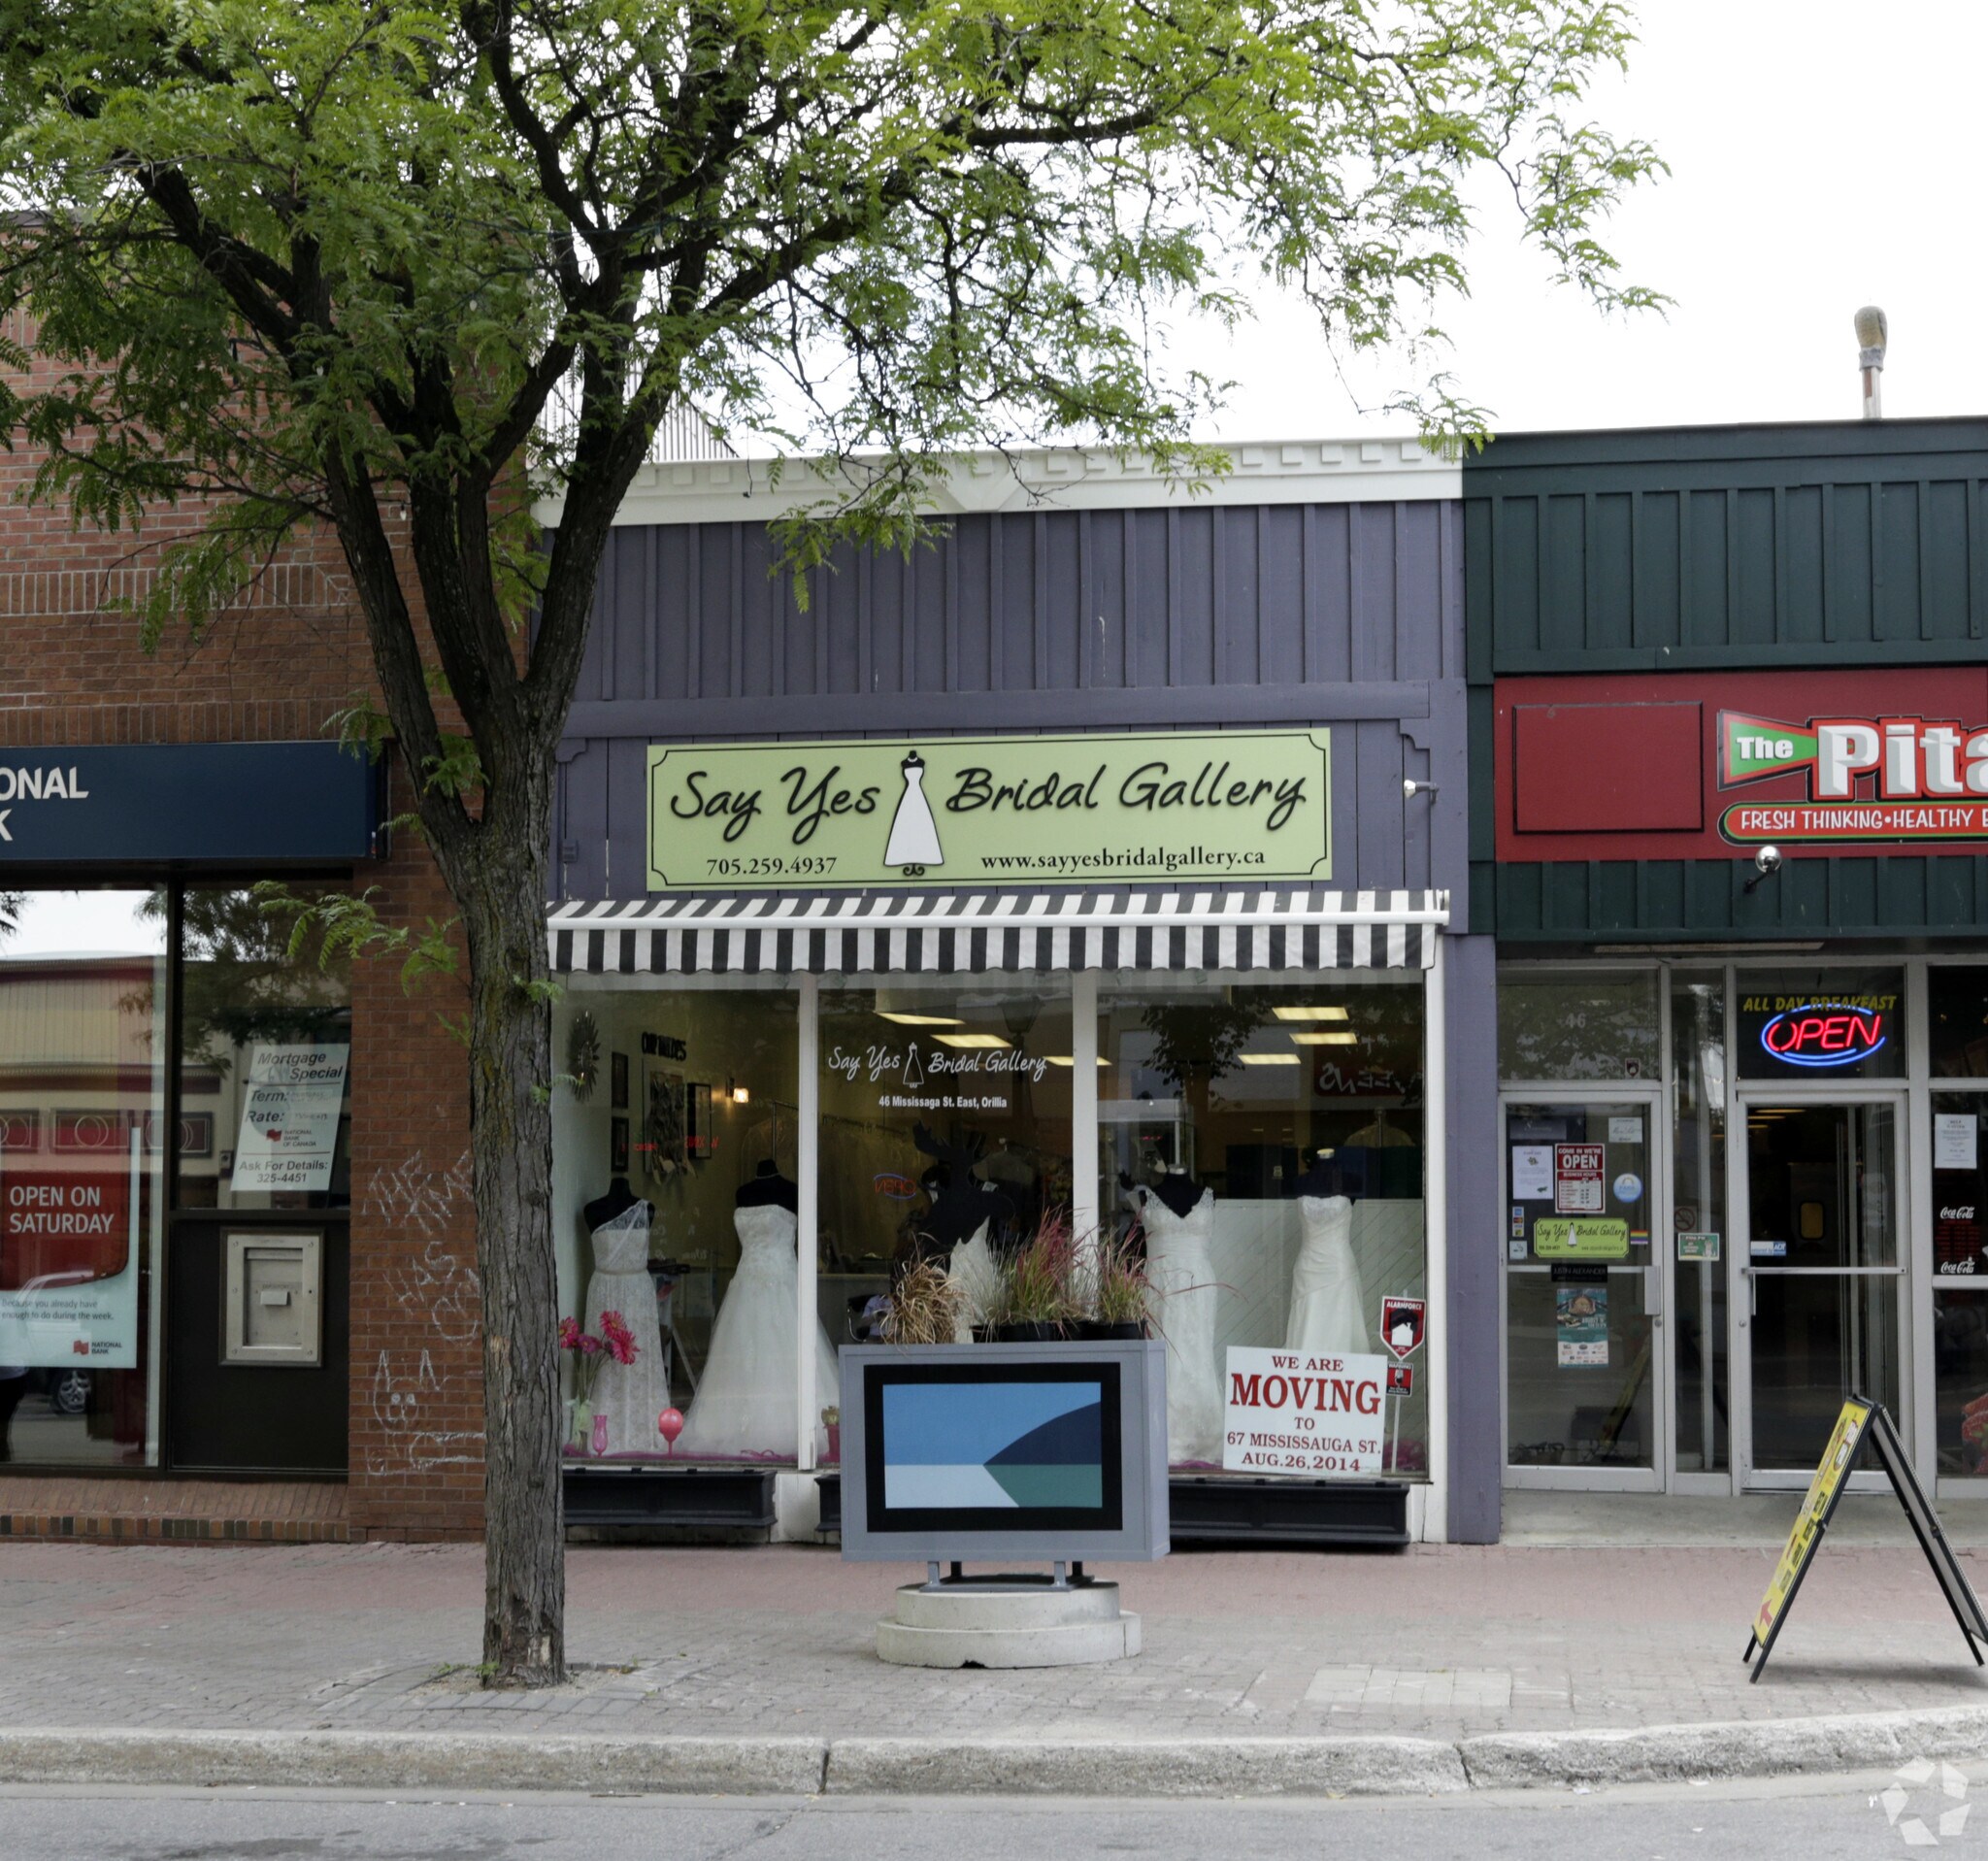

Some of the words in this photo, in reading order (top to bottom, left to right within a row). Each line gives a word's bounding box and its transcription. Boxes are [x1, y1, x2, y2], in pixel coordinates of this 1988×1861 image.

[1736, 736, 1794, 760] The
[0, 765, 89, 801] ONAL
[670, 770, 762, 843] Say
[779, 765, 880, 846] Yes
[945, 764, 1108, 813] Bridal
[1118, 761, 1307, 832] Gallery
[1740, 810, 1796, 830] FRESH
[706, 856, 838, 876] 705.259.4937
[980, 846, 1266, 874] www.sayyesbridalgallery.ca
[1743, 996, 1770, 1012] ALL
[1774, 996, 1806, 1012] DAY
[1809, 995, 1897, 1012] BREAKFAST
[1767, 1015, 1881, 1052] OPEN
[257, 1052, 327, 1067] Mortgage
[828, 1046, 861, 1080] Say
[866, 1045, 901, 1081] Yes
[927, 1050, 982, 1074] Bridal
[985, 1049, 1047, 1082] Gallery
[290, 1066, 344, 1082] Special
[251, 1089, 290, 1103] Term:
[878, 1096, 890, 1108] 46
[892, 1095, 941, 1110] Mississaga
[943, 1096, 955, 1108] St.
[957, 1096, 979, 1110] East,
[981, 1095, 1008, 1109] Orillia
[245, 1111, 285, 1123] Rate:
[239, 1160, 261, 1171] Ask
[265, 1160, 282, 1171] For
[286, 1160, 329, 1171] Details:
[1563, 1154, 1599, 1169] OPEN
[256, 1173, 307, 1183] 325-4451
[10, 1185, 64, 1207] OPEN
[70, 1185, 101, 1207] ON
[9, 1213, 115, 1234] SATURDAY
[1538, 1223, 1551, 1242] Say
[1553, 1223, 1568, 1243] Yes
[1575, 1224, 1598, 1237] Bridal
[1600, 1224, 1626, 1243] Gallery
[35, 1301, 49, 1310] you
[50, 1299, 78, 1310] already
[80, 1299, 98, 1308] have
[1386, 1301, 1422, 1311] ALARMFORCE
[2, 1312, 29, 1321] enough
[52, 1311, 77, 1321] during
[91, 1312, 115, 1320] week.
[1272, 1355, 1299, 1370] WE
[1305, 1358, 1344, 1372] ARE
[1229, 1372, 1381, 1414] MOVING
[1294, 1416, 1315, 1431] TO
[1227, 1431, 1245, 1446] 67
[1249, 1433, 1353, 1453] MISSISSAUGA
[1358, 1440, 1381, 1454] ST.
[1242, 1451, 1361, 1473] AUG.26,2014
